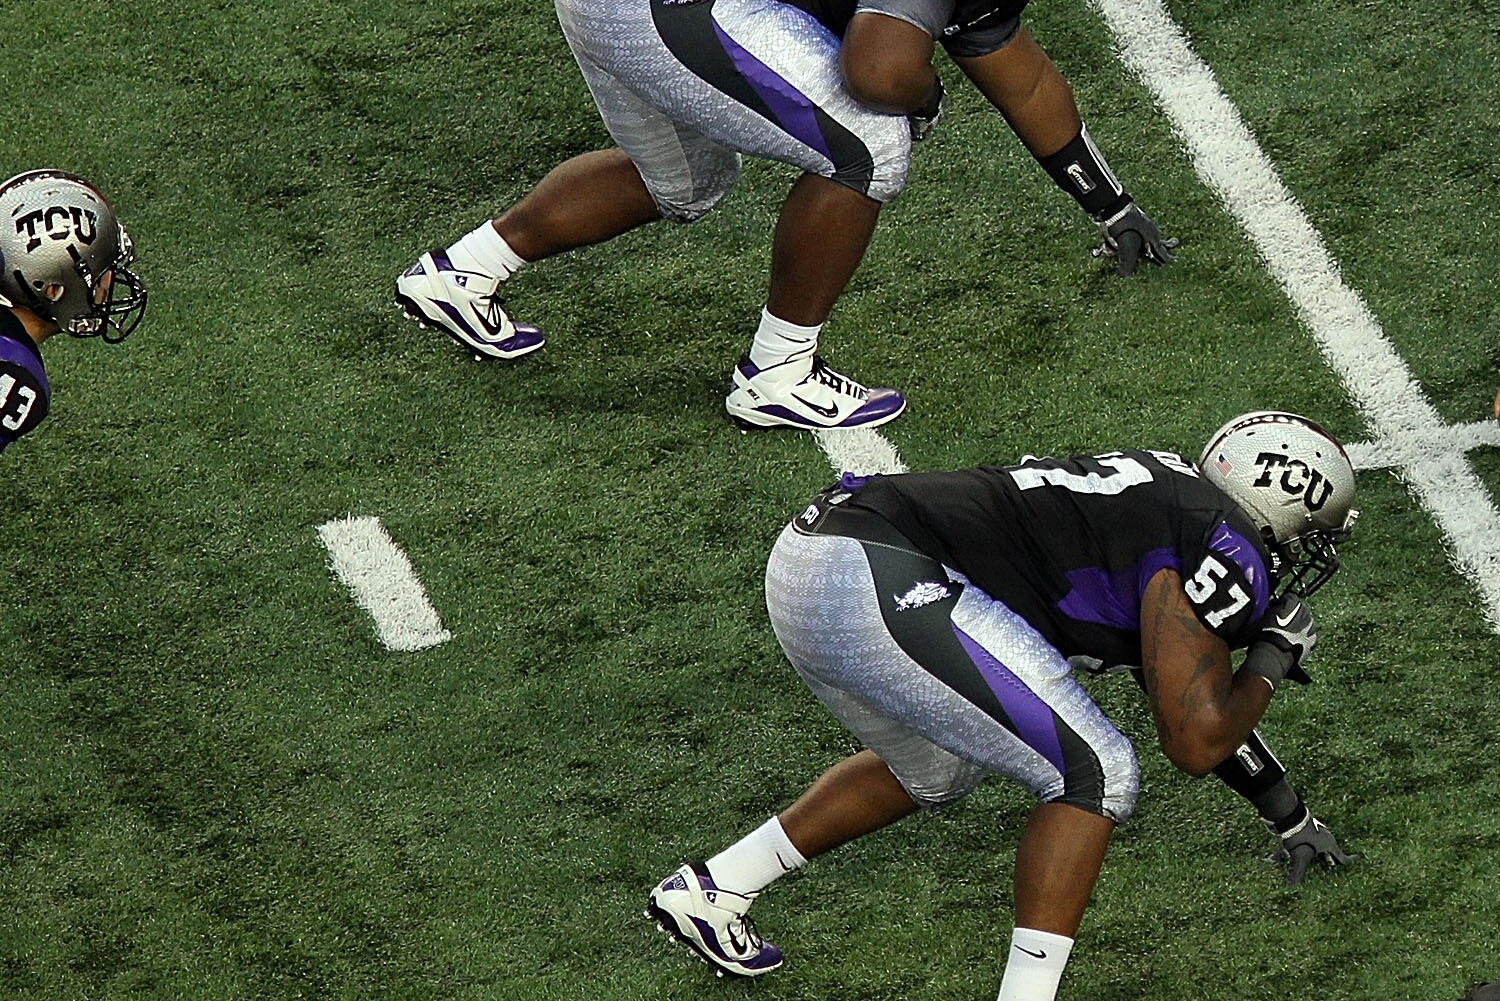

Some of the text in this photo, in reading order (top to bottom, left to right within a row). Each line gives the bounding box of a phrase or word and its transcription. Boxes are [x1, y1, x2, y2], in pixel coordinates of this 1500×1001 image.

[15, 204, 97, 255] TCU
[1252, 451, 1337, 513] TCU
[1184, 554, 1252, 629] 57
